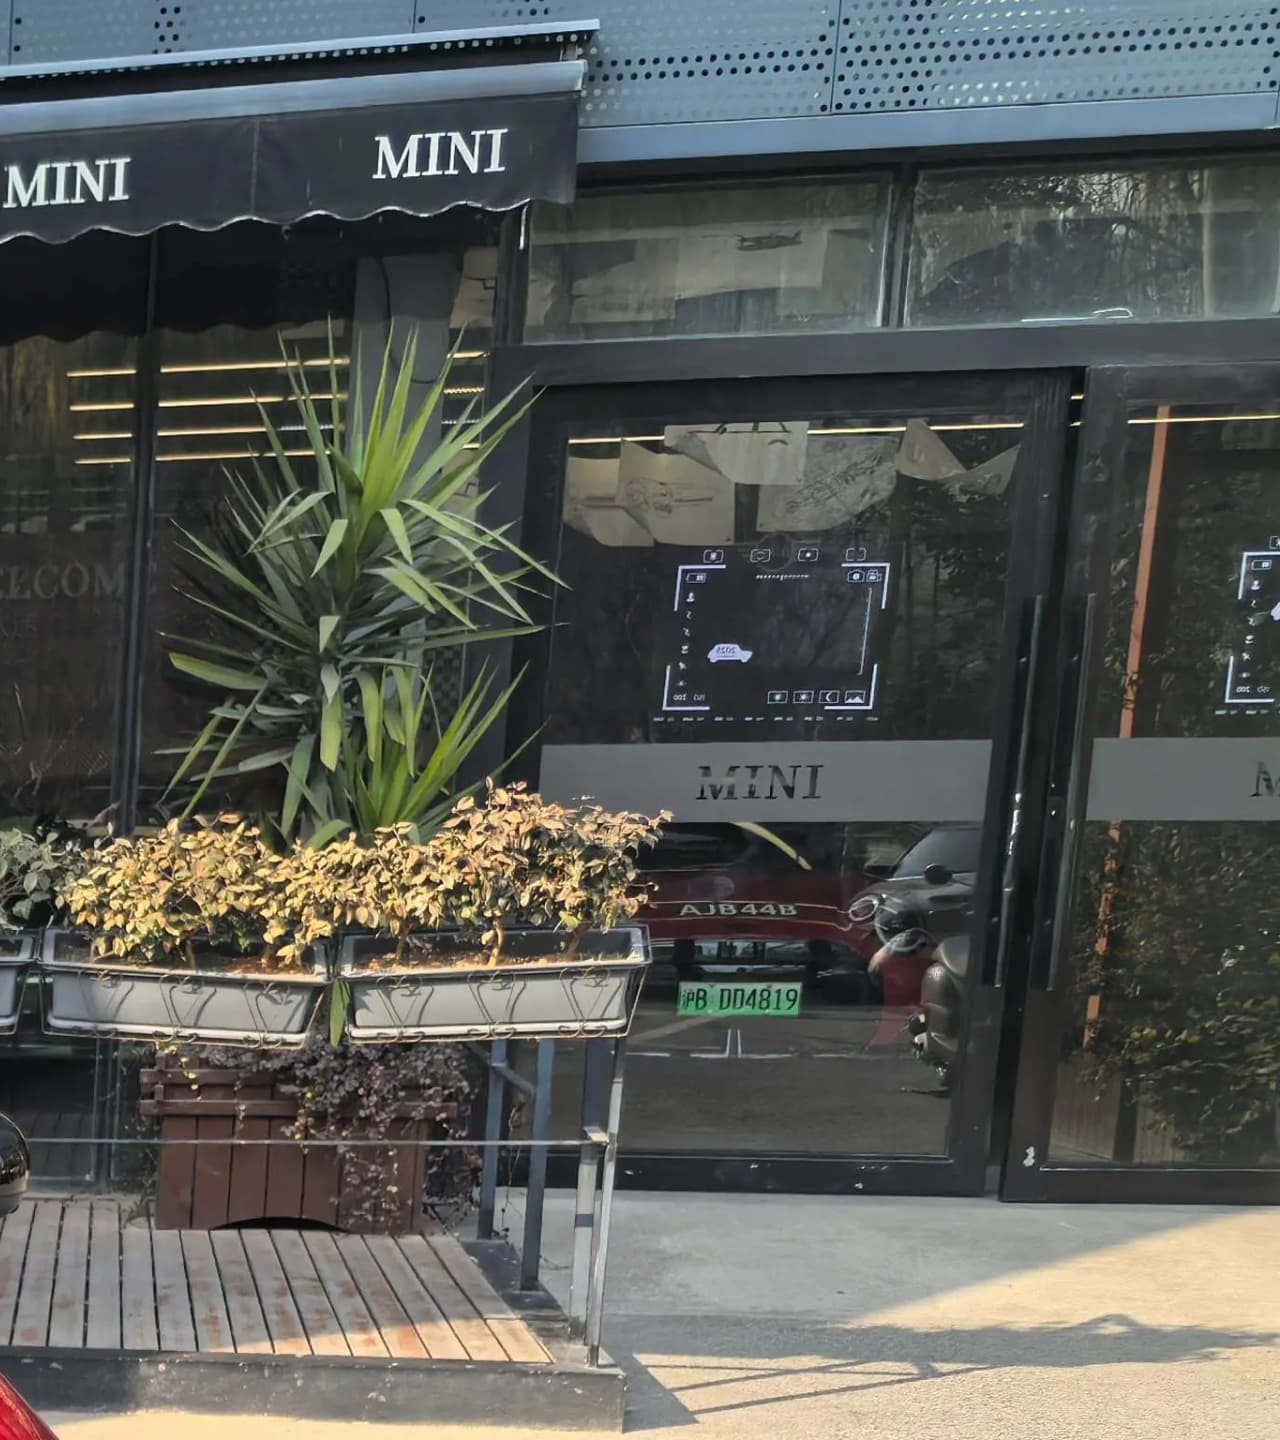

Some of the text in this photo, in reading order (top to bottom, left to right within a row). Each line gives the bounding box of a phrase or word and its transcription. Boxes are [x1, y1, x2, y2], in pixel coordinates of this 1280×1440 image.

[372, 127, 509, 180] MINI
[2, 156, 132, 209] MINI
[695, 764, 825, 801] MINI
